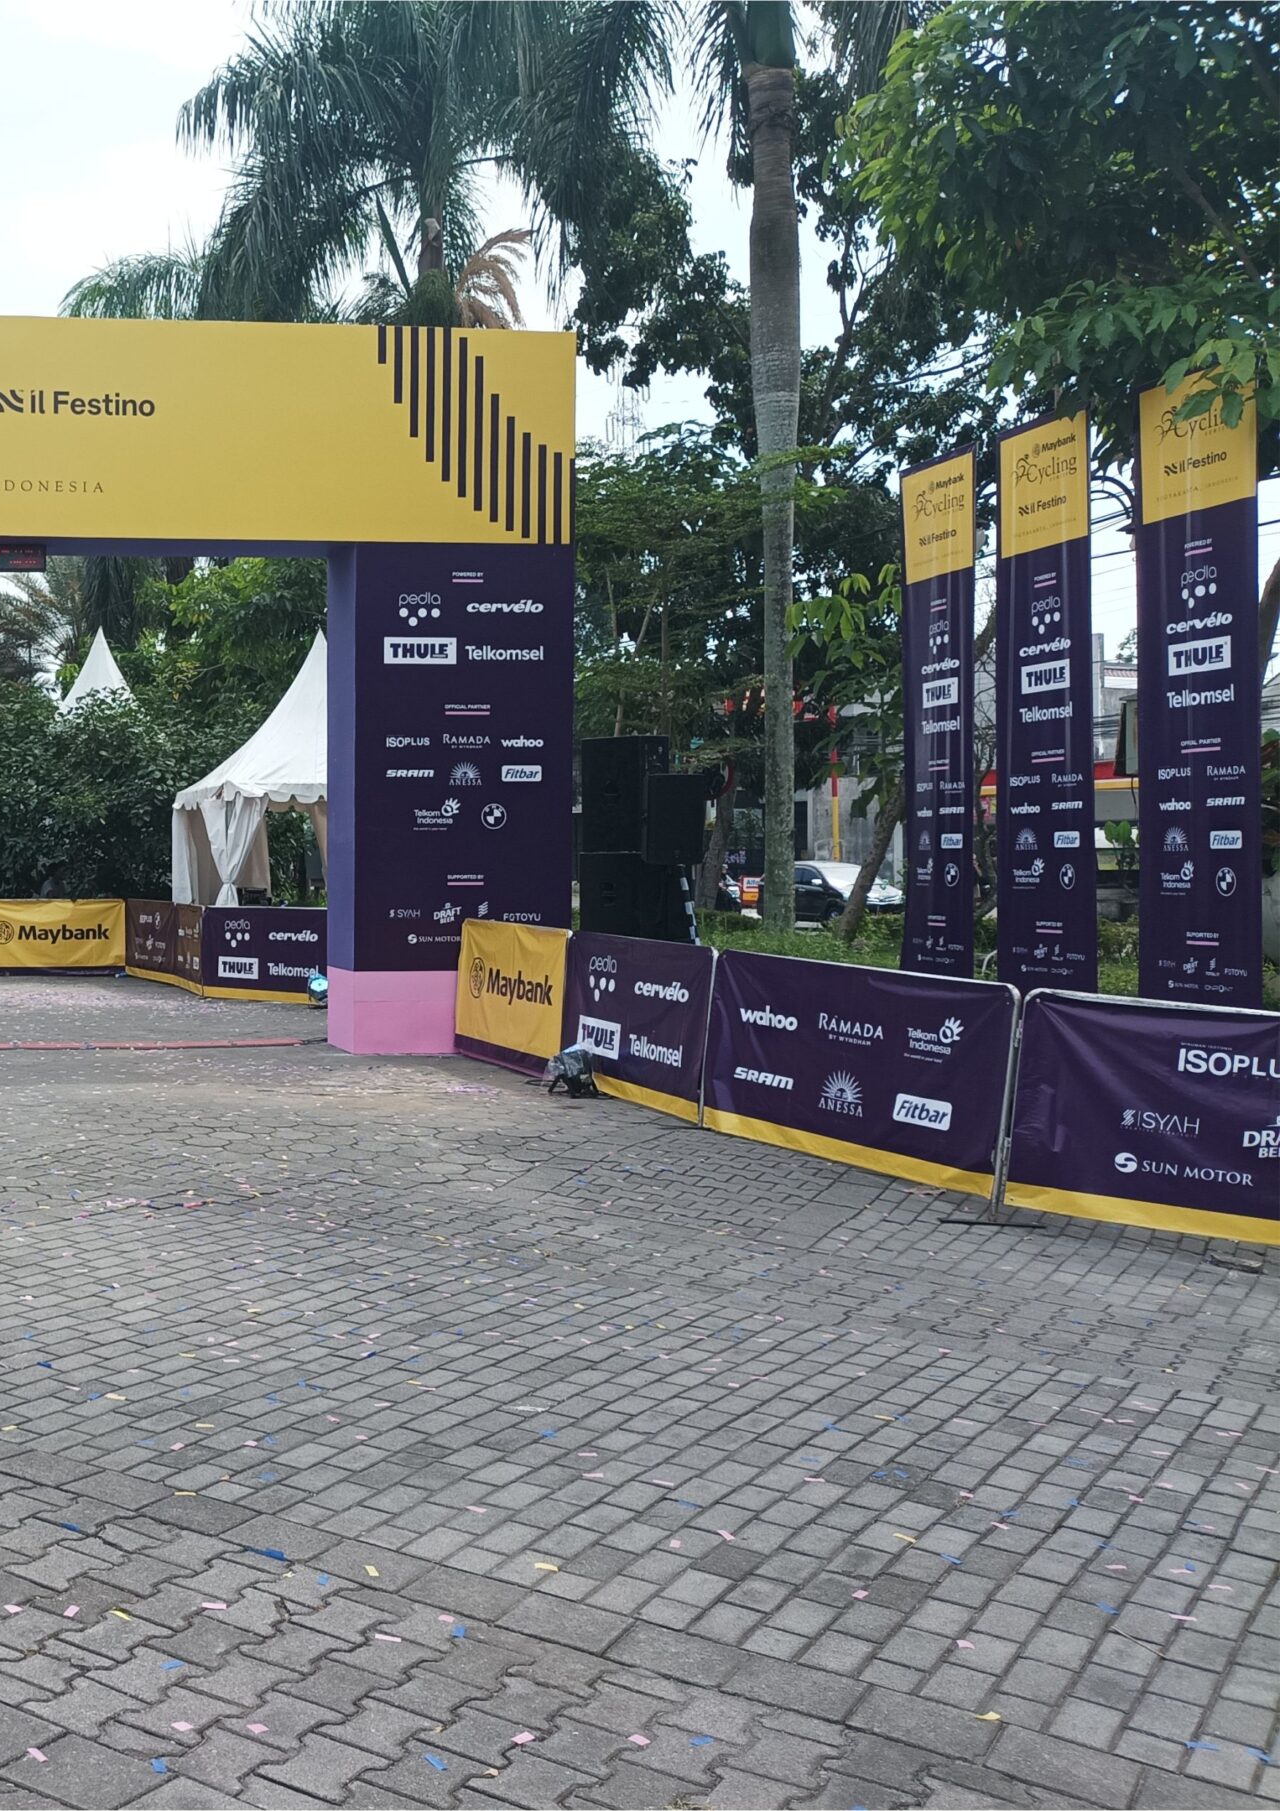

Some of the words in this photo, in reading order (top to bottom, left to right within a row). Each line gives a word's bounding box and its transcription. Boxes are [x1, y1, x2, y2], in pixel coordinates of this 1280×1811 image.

[53, 391, 156, 417] Festino
[1041, 433, 1076, 453] Maybank
[1186, 451, 1227, 471] Festino
[1026, 456, 1077, 485] Cycling
[1036, 495, 1067, 513] Festino
[466, 600, 544, 613] cervélo
[1166, 612, 1233, 634] cervélo
[390, 643, 449, 659] THULE
[465, 645, 544, 661] Telkomsel
[1019, 637, 1071, 657] cervélo
[1173, 644, 1224, 669] THULE
[1026, 666, 1066, 687] THULE
[1167, 684, 1235, 708] Telkomsel
[1019, 701, 1072, 723] Telkomsel
[386, 736, 430, 748] ISOPLUS
[443, 734, 491, 744] RAMADA
[501, 735, 544, 748] wahoo
[385, 769, 435, 778] SRAM
[504, 768, 540, 780] Fitbar
[1051, 773, 1083, 783] RAMADA
[1158, 767, 1191, 780] ISOPLUS
[1206, 765, 1246, 776] RAMADA
[449, 778, 482, 786] ANESSA
[1010, 775, 1040, 787] ISOPLUS
[1011, 802, 1040, 815] wahoo
[1051, 801, 1082, 810] SRAM
[1159, 798, 1191, 811] wahoo
[1206, 797, 1245, 807] SRAM
[414, 809, 441, 818] Telkom
[417, 817, 453, 825] Indonesia
[1056, 834, 1078, 845] Fitbar
[1212, 834, 1240, 846] Fitbar
[434, 906, 462, 920] DRAFT
[18, 924, 109, 944] Maybank
[269, 930, 318, 942] cervélo
[222, 961, 254, 975] THULE
[268, 963, 319, 977] Telkomsel
[486, 967, 553, 1006] Maybank
[634, 980, 689, 1003] cervélo
[740, 1005, 798, 1031] wahoo
[818, 1012, 884, 1040] RAMADA
[581, 1023, 616, 1051] THULE
[907, 1027, 937, 1042] Telkom
[629, 1033, 682, 1068] Telkomsel
[909, 1039, 951, 1055] Indonesia
[733, 1066, 794, 1091] SRAM
[819, 1097, 863, 1118] ANESSA
[896, 1099, 949, 1125] Fitbar
[1142, 1111, 1200, 1135] SYAH
[1242, 1130, 1280, 1148] DR
[1258, 1147, 1280, 1158] BE
[1141, 1160, 1178, 1176] SUN
[1183, 1166, 1253, 1187] MOTOR
